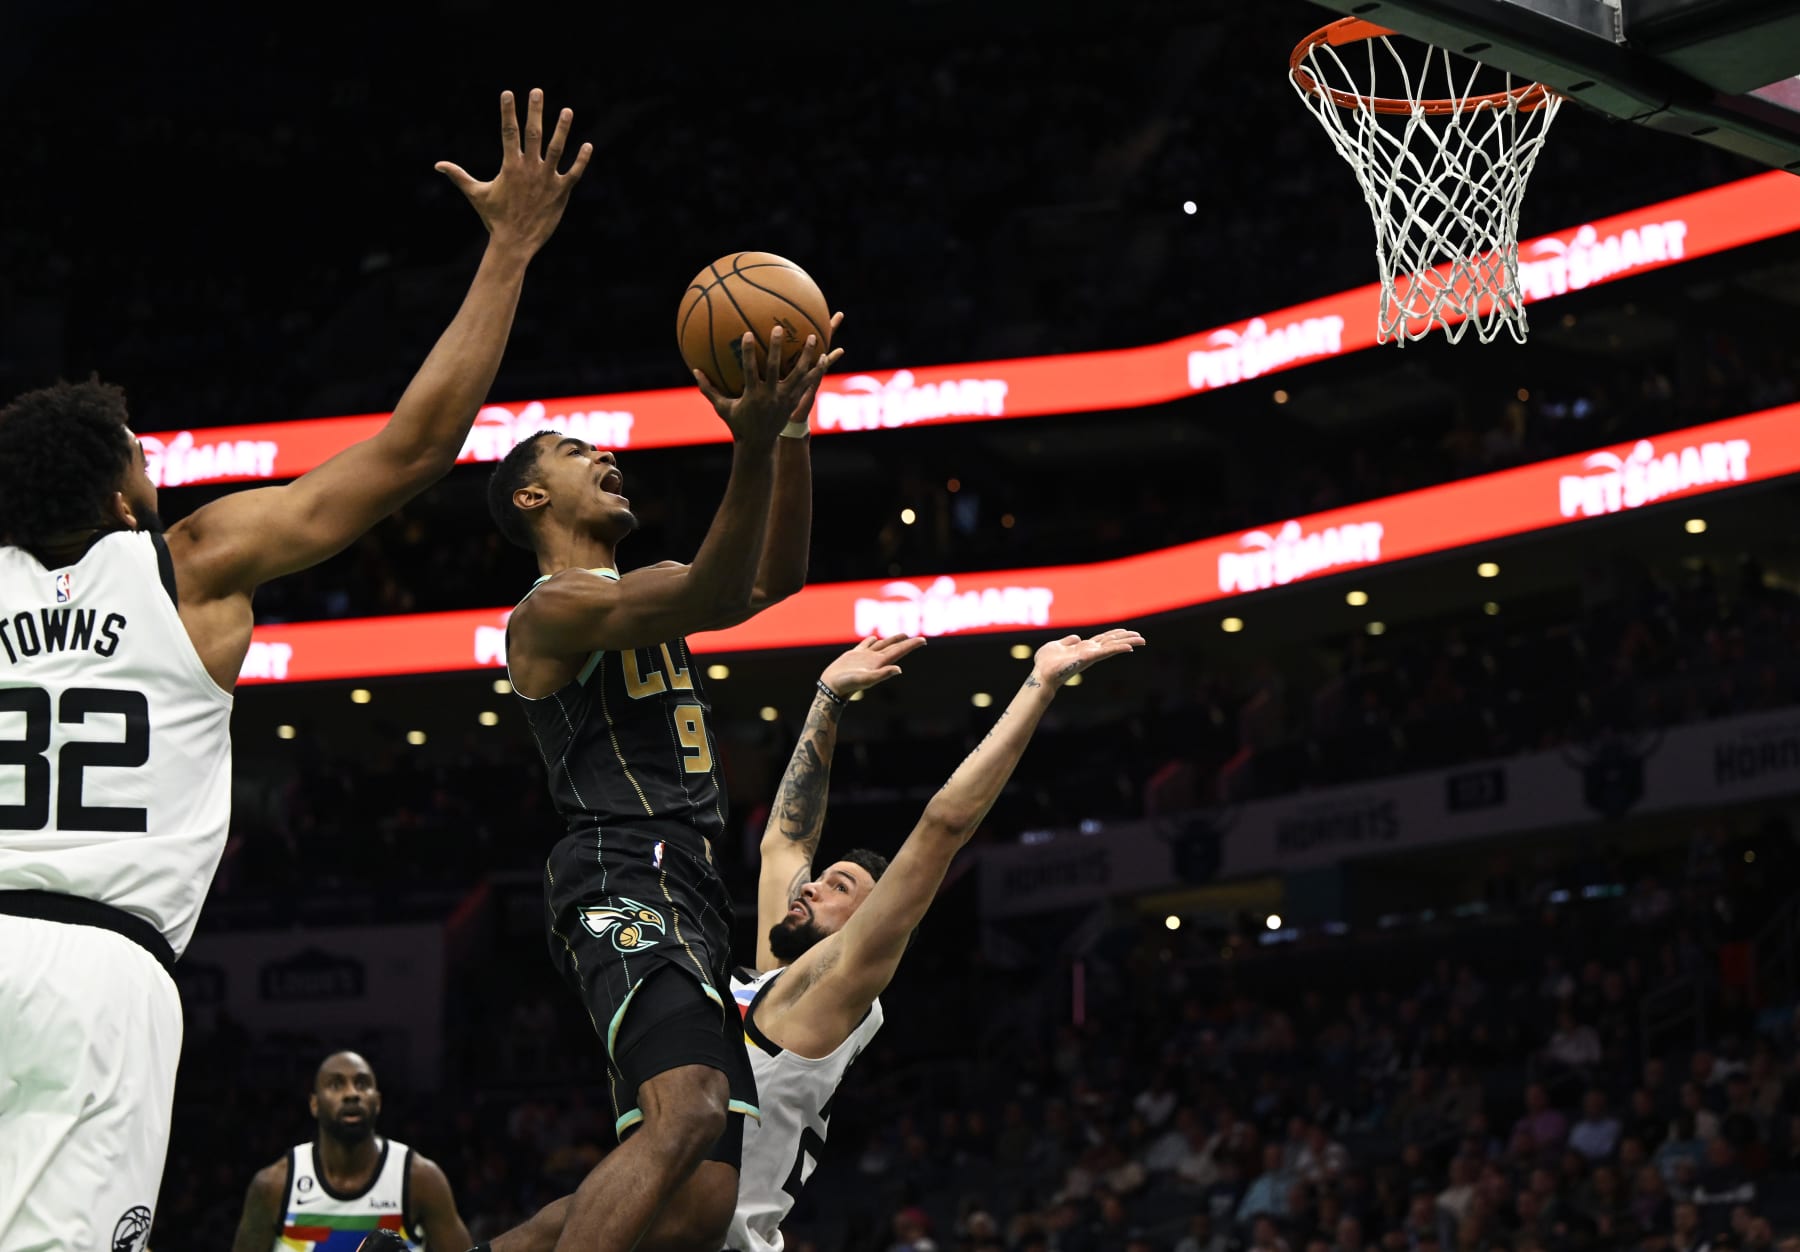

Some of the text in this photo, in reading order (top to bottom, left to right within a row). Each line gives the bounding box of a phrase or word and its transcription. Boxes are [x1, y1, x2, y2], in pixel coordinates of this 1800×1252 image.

[1188, 316, 1344, 388] PETSMART
[817, 369, 1008, 430] PETSMART
[1559, 440, 1750, 517] PETSMART
[1218, 521, 1384, 593] PETSMART
[0, 608, 127, 664] TOWNS
[855, 577, 1053, 638] PETSMART
[674, 705, 713, 773] 9
